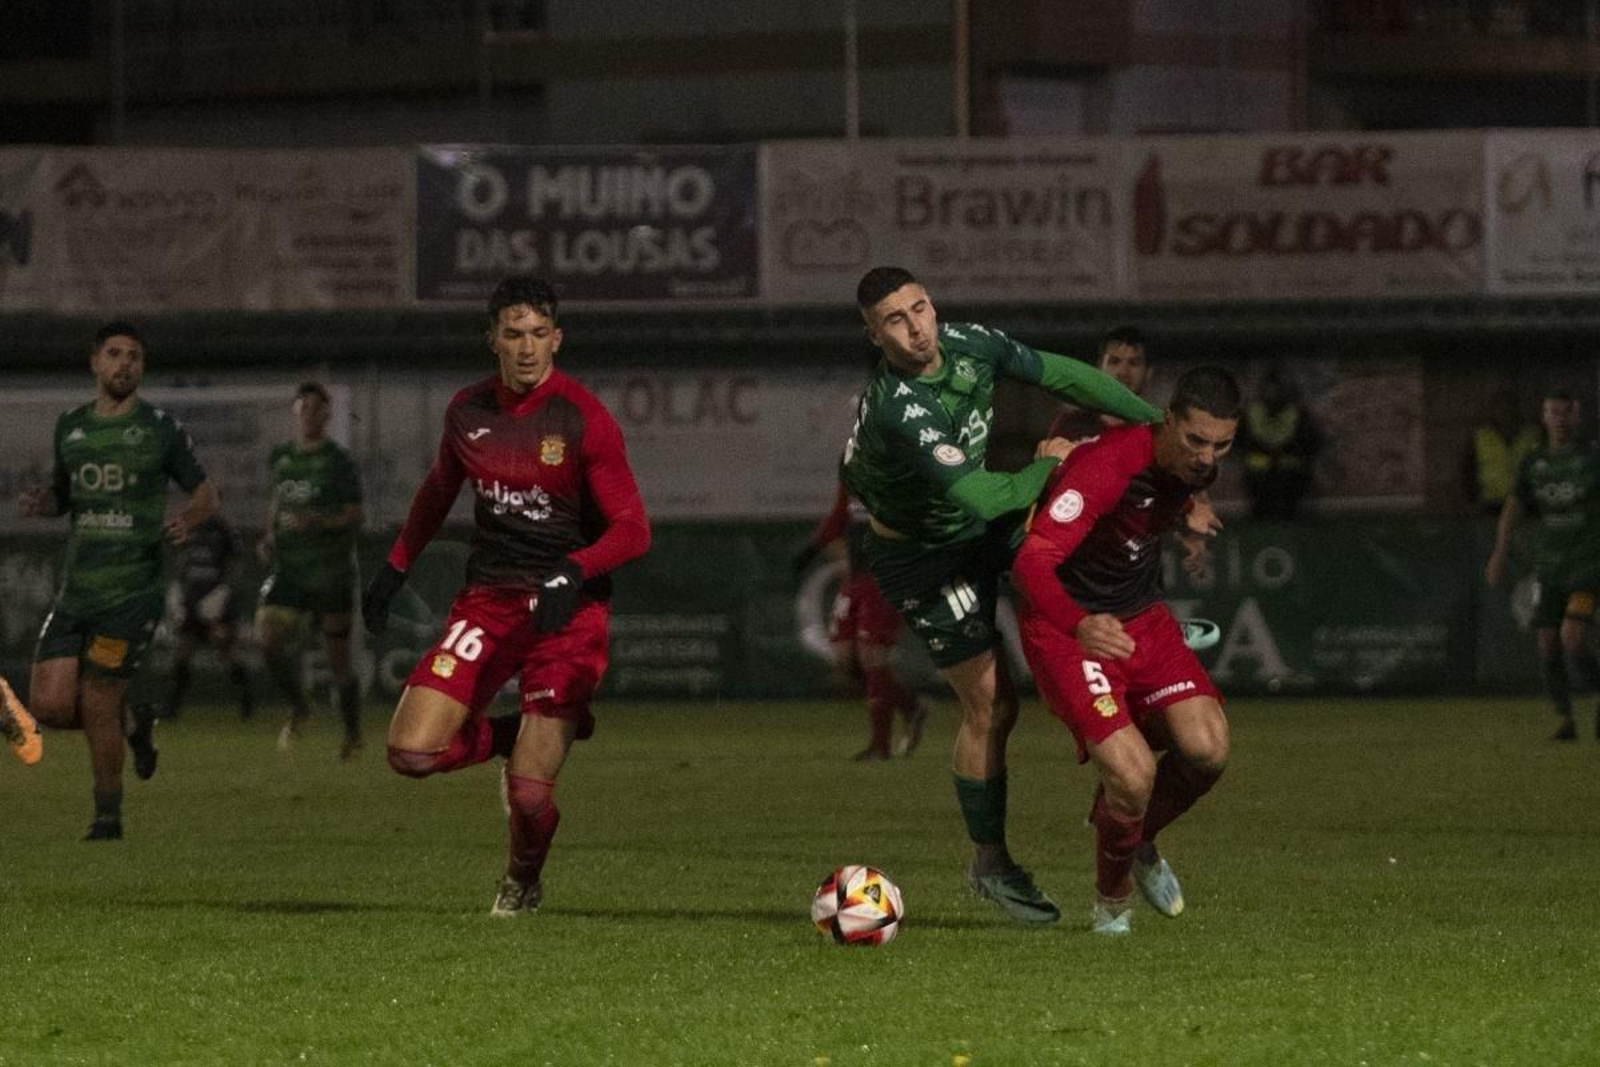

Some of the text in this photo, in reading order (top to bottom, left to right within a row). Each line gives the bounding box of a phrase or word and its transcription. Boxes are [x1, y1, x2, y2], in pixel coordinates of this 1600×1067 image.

[1260, 146, 1392, 186] BAR
[458, 163, 508, 219] O
[894, 172, 1113, 229] Brawin
[456, 226, 721, 274] DAS LOUSAS
[1172, 210, 1484, 257] SOLDADO
[440, 619, 485, 662] 16
[1082, 659, 1112, 695] 5
